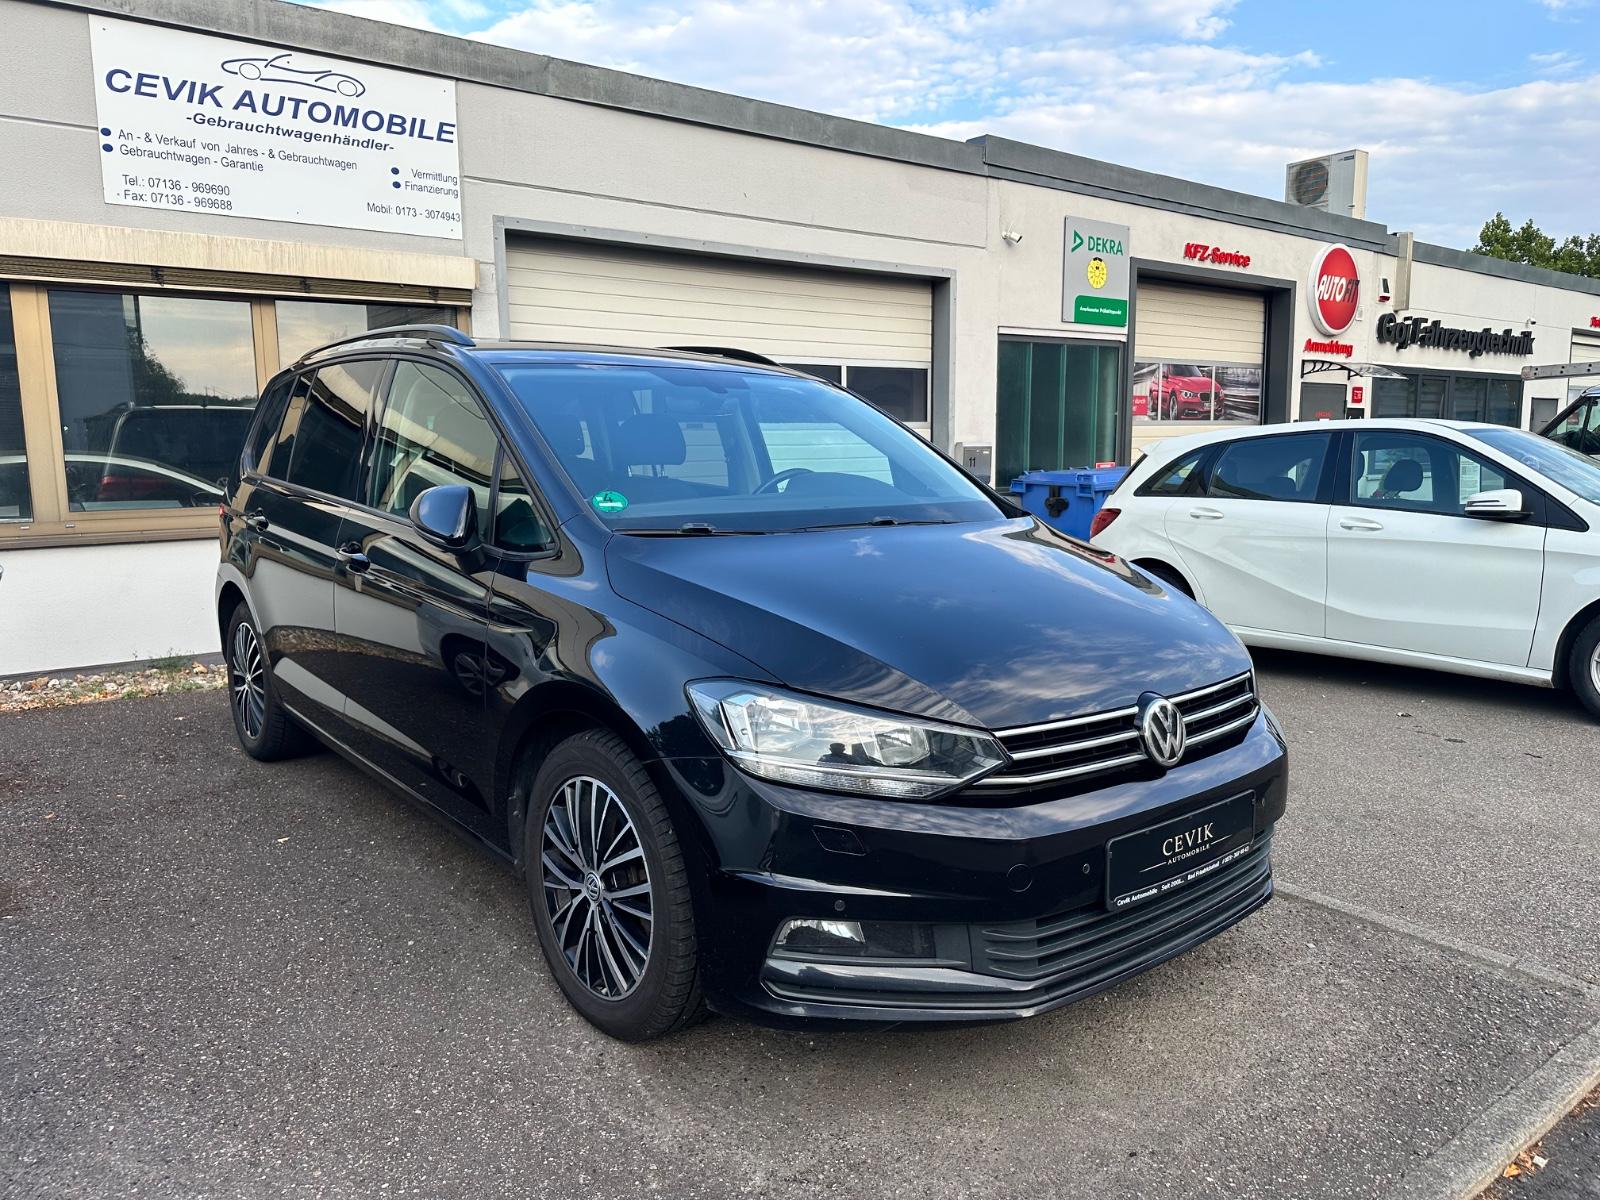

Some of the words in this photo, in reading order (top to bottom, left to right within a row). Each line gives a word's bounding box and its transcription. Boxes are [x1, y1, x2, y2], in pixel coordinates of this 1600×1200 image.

[105, 68, 224, 109] CEVIK
[232, 90, 456, 144] AUTOMOBILE
[186, 112, 395, 151] -Gebrauchtwagenhändler-
[118, 129, 134, 141] An
[144, 132, 152, 143] &
[155, 134, 196, 149] Verkauf
[201, 141, 220, 152] von
[224, 144, 258, 157] Jahres
[268, 149, 275, 159] &
[278, 150, 357, 171] Gebrauchtwagen
[119, 144, 211, 166] Gebrauchtwagen
[220, 157, 264, 172] Garantie
[122, 174, 145, 187] Tel.:
[148, 177, 182, 191] 07136
[191, 182, 230, 196] 969690
[411, 168, 458, 186] Vermittlung
[124, 189, 147, 203] Fax:
[150, 192, 184, 206] 07136
[194, 197, 233, 211] 969688
[404, 181, 459, 199] Finanzierung
[367, 202, 393, 215] Mobil:
[395, 205, 417, 218] 0173
[425, 209, 461, 222] 3074943
[1087, 236, 1124, 256] DEKRA
[1183, 243, 1251, 268] KFZ-Service
[1410, 317, 1536, 358] Fahrzeugtechnik
[968, 457, 976, 467] 11
[1162, 822, 1214, 856] CEVIK
[1167, 843, 1210, 865] AUTOMOBILE
